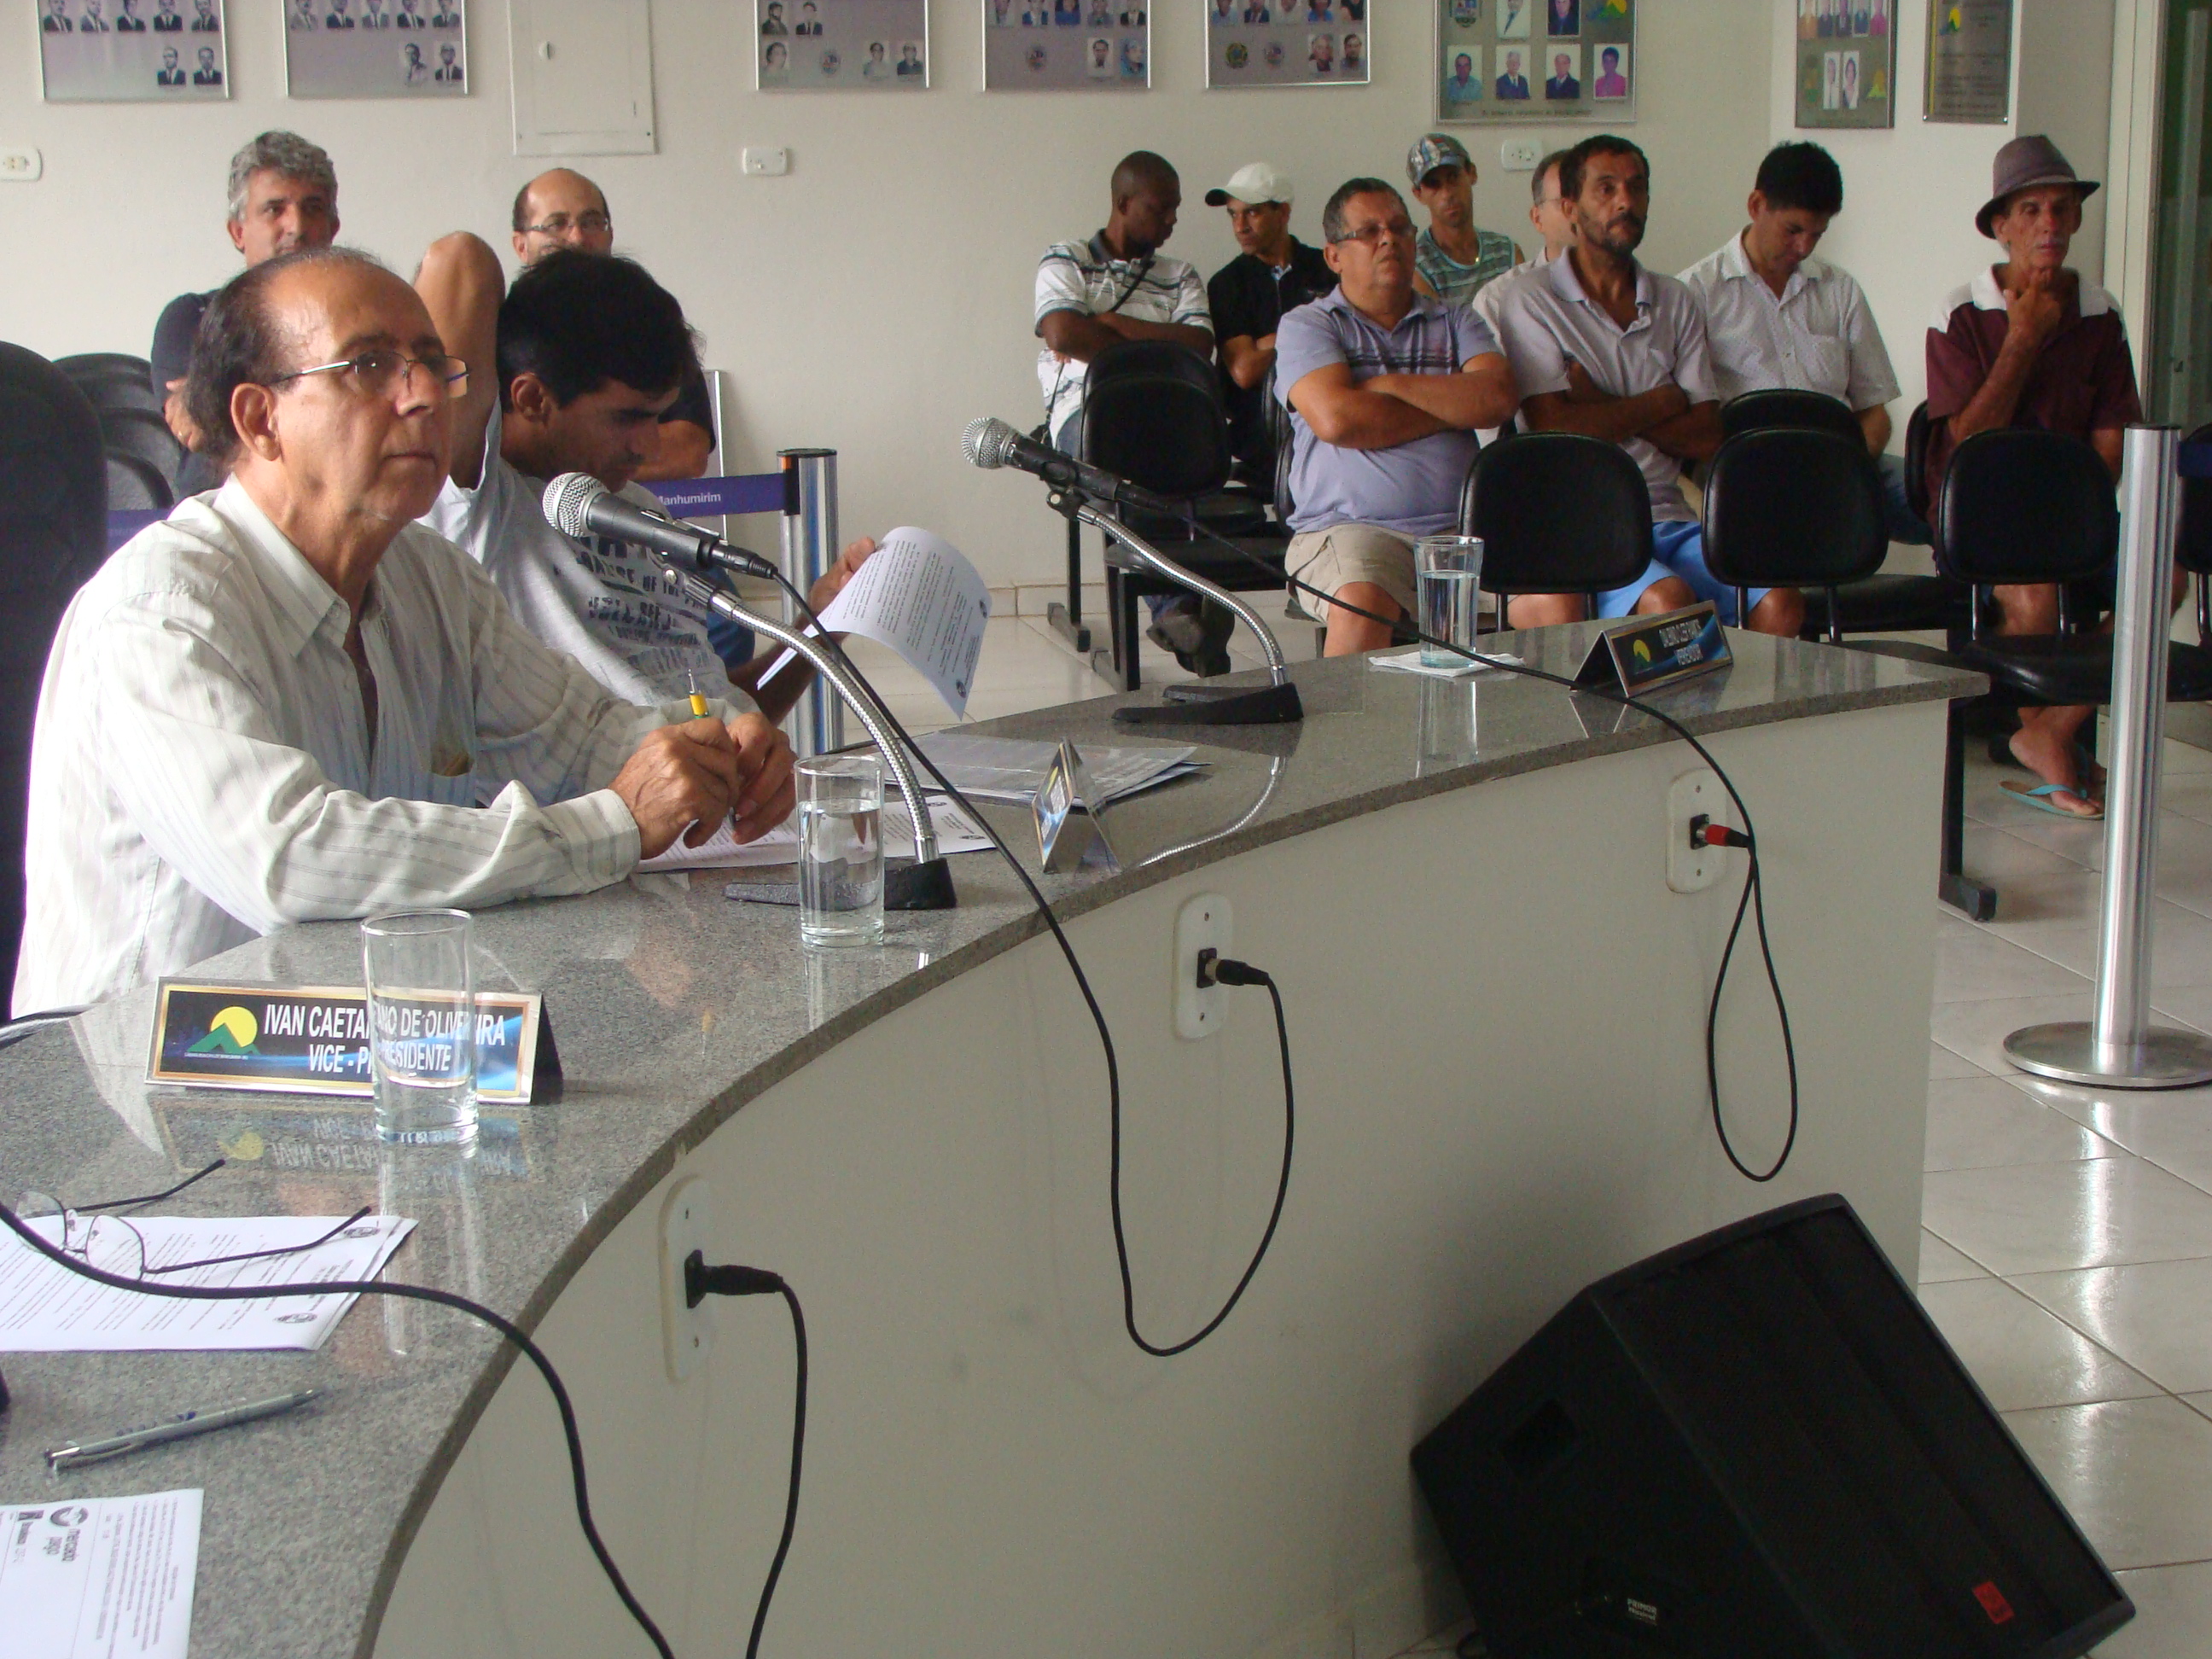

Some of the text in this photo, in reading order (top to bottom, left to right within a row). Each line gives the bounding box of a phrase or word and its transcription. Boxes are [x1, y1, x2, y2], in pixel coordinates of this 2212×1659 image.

[263, 1004, 306, 1036] IVAN
[400, 1008, 422, 1037] DE
[309, 1044, 346, 1073] VICE
